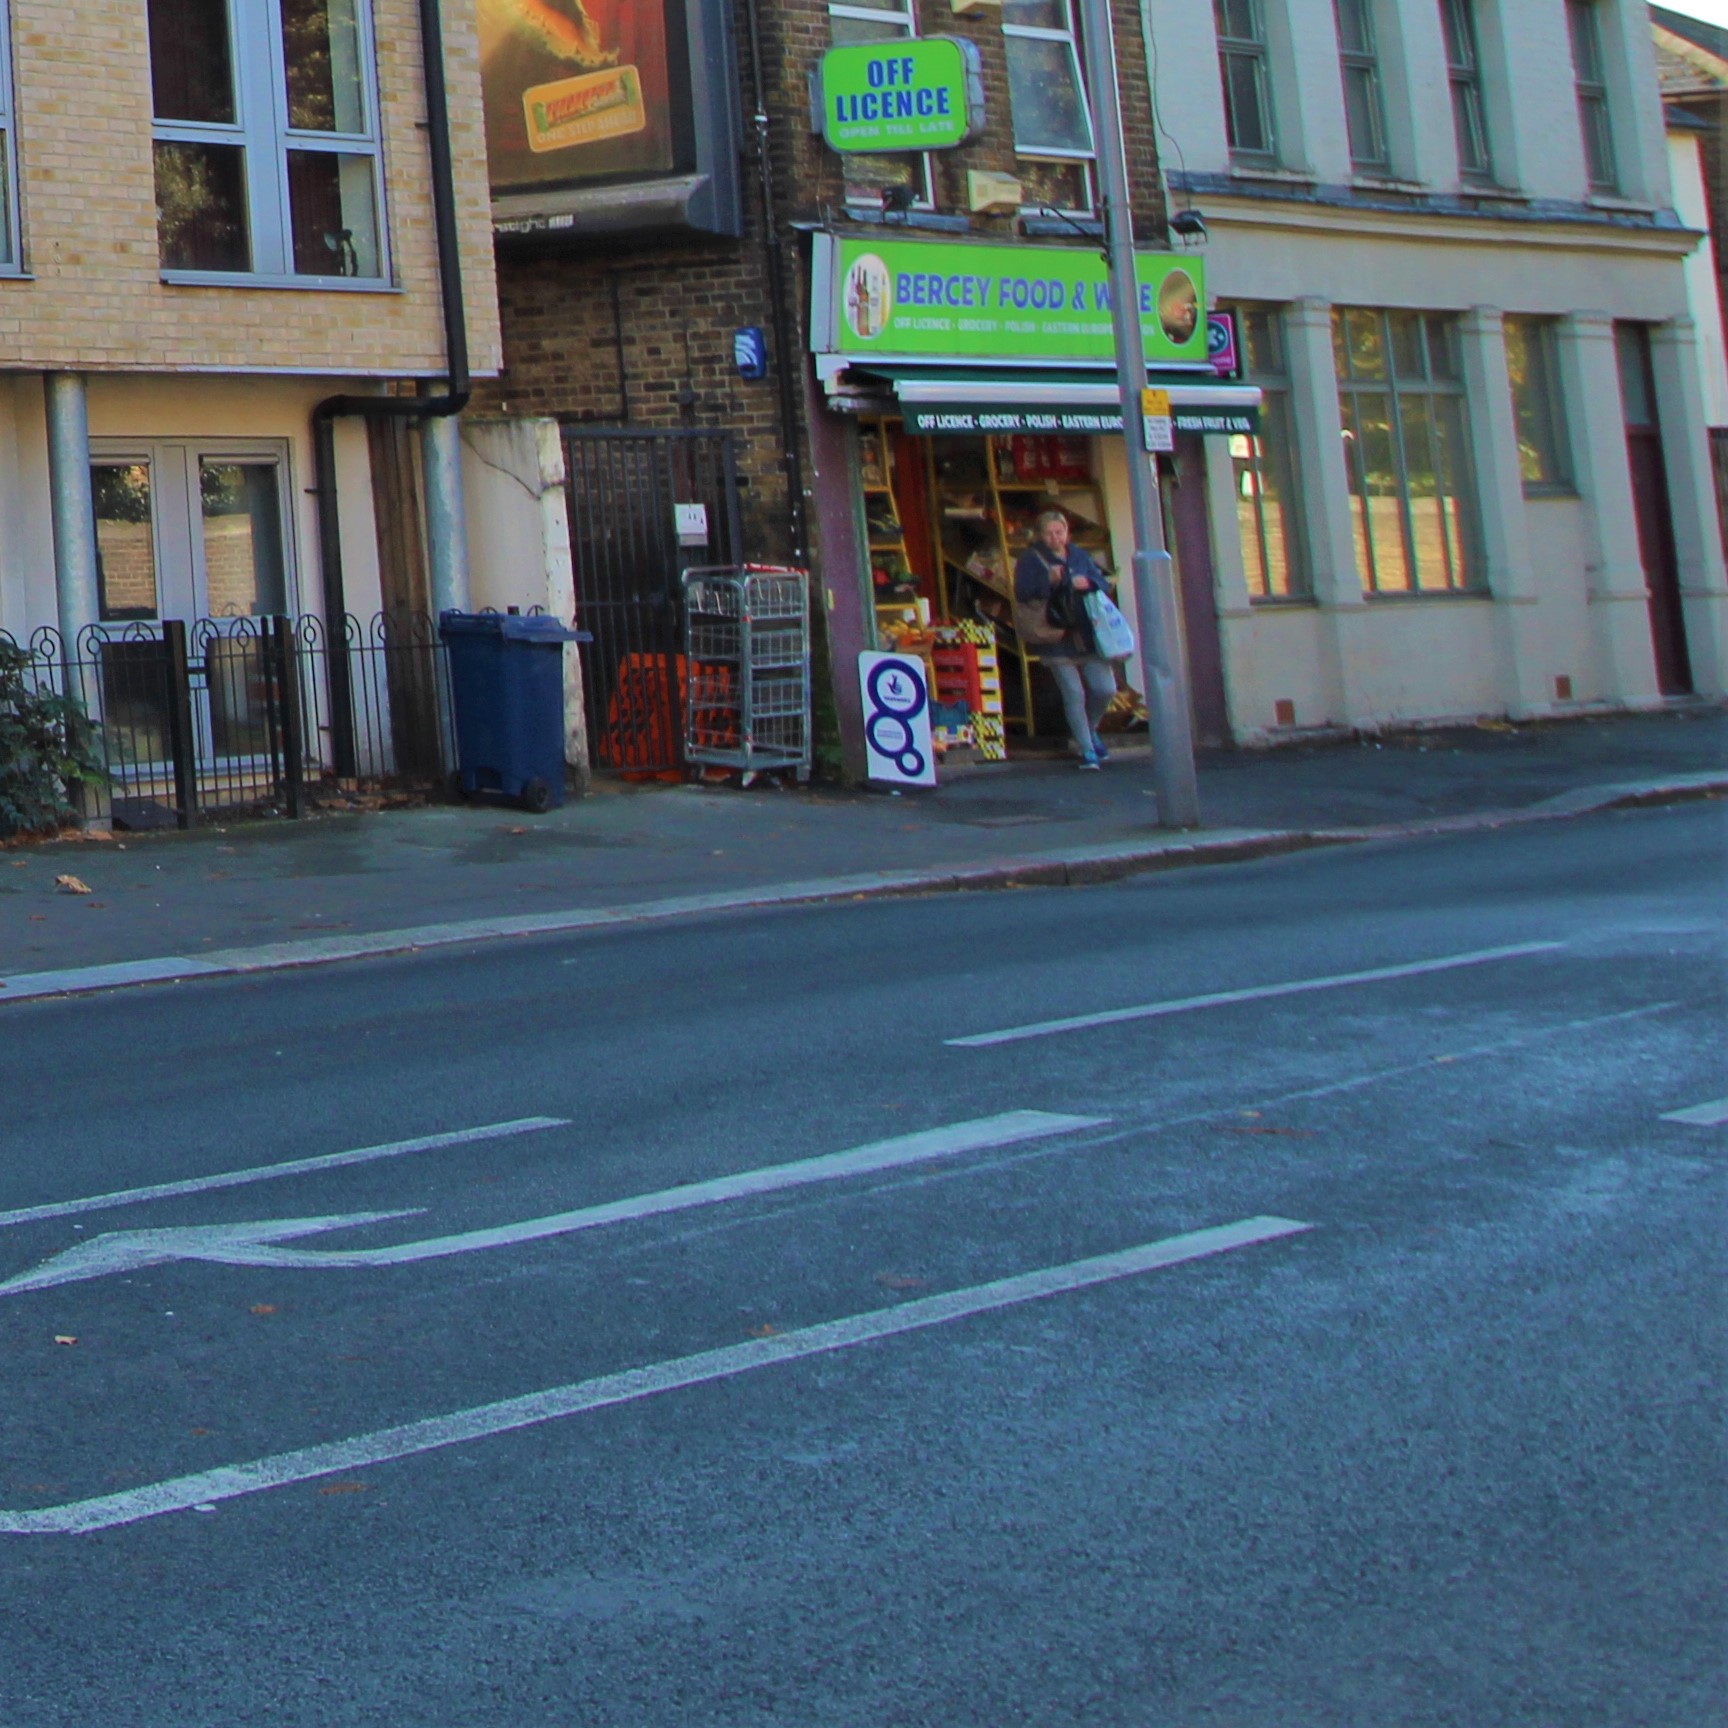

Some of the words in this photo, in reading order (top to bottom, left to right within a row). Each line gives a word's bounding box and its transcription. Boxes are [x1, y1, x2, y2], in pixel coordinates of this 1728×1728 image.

[867, 57, 914, 88] OFF
[836, 87, 950, 123] LICENCE
[537, 126, 565, 144] ONE
[839, 126, 881, 139] OPEN
[886, 123, 913, 136] TILL
[919, 119, 955, 133] LATE
[896, 272, 992, 308] BERCEY
[998, 277, 1065, 310] FOOD
[1072, 281, 1087, 311] &
[1094, 282, 1153, 313] WE
[894, 316, 911, 329] OFF
[913, 317, 951, 331] LICENCE
[957, 318, 998, 333] GROCERY
[917, 414, 936, 430] OFF
[936, 414, 975, 430] LICENCE
[978, 414, 1021, 430] GROCERY
[1025, 414, 1058, 430] POLISH
[1061, 414, 1101, 430] EASTERN
[1177, 415, 1204, 430] FRESH
[1202, 415, 1226, 430] FRUIT
[1231, 416, 1251, 431] VEG
